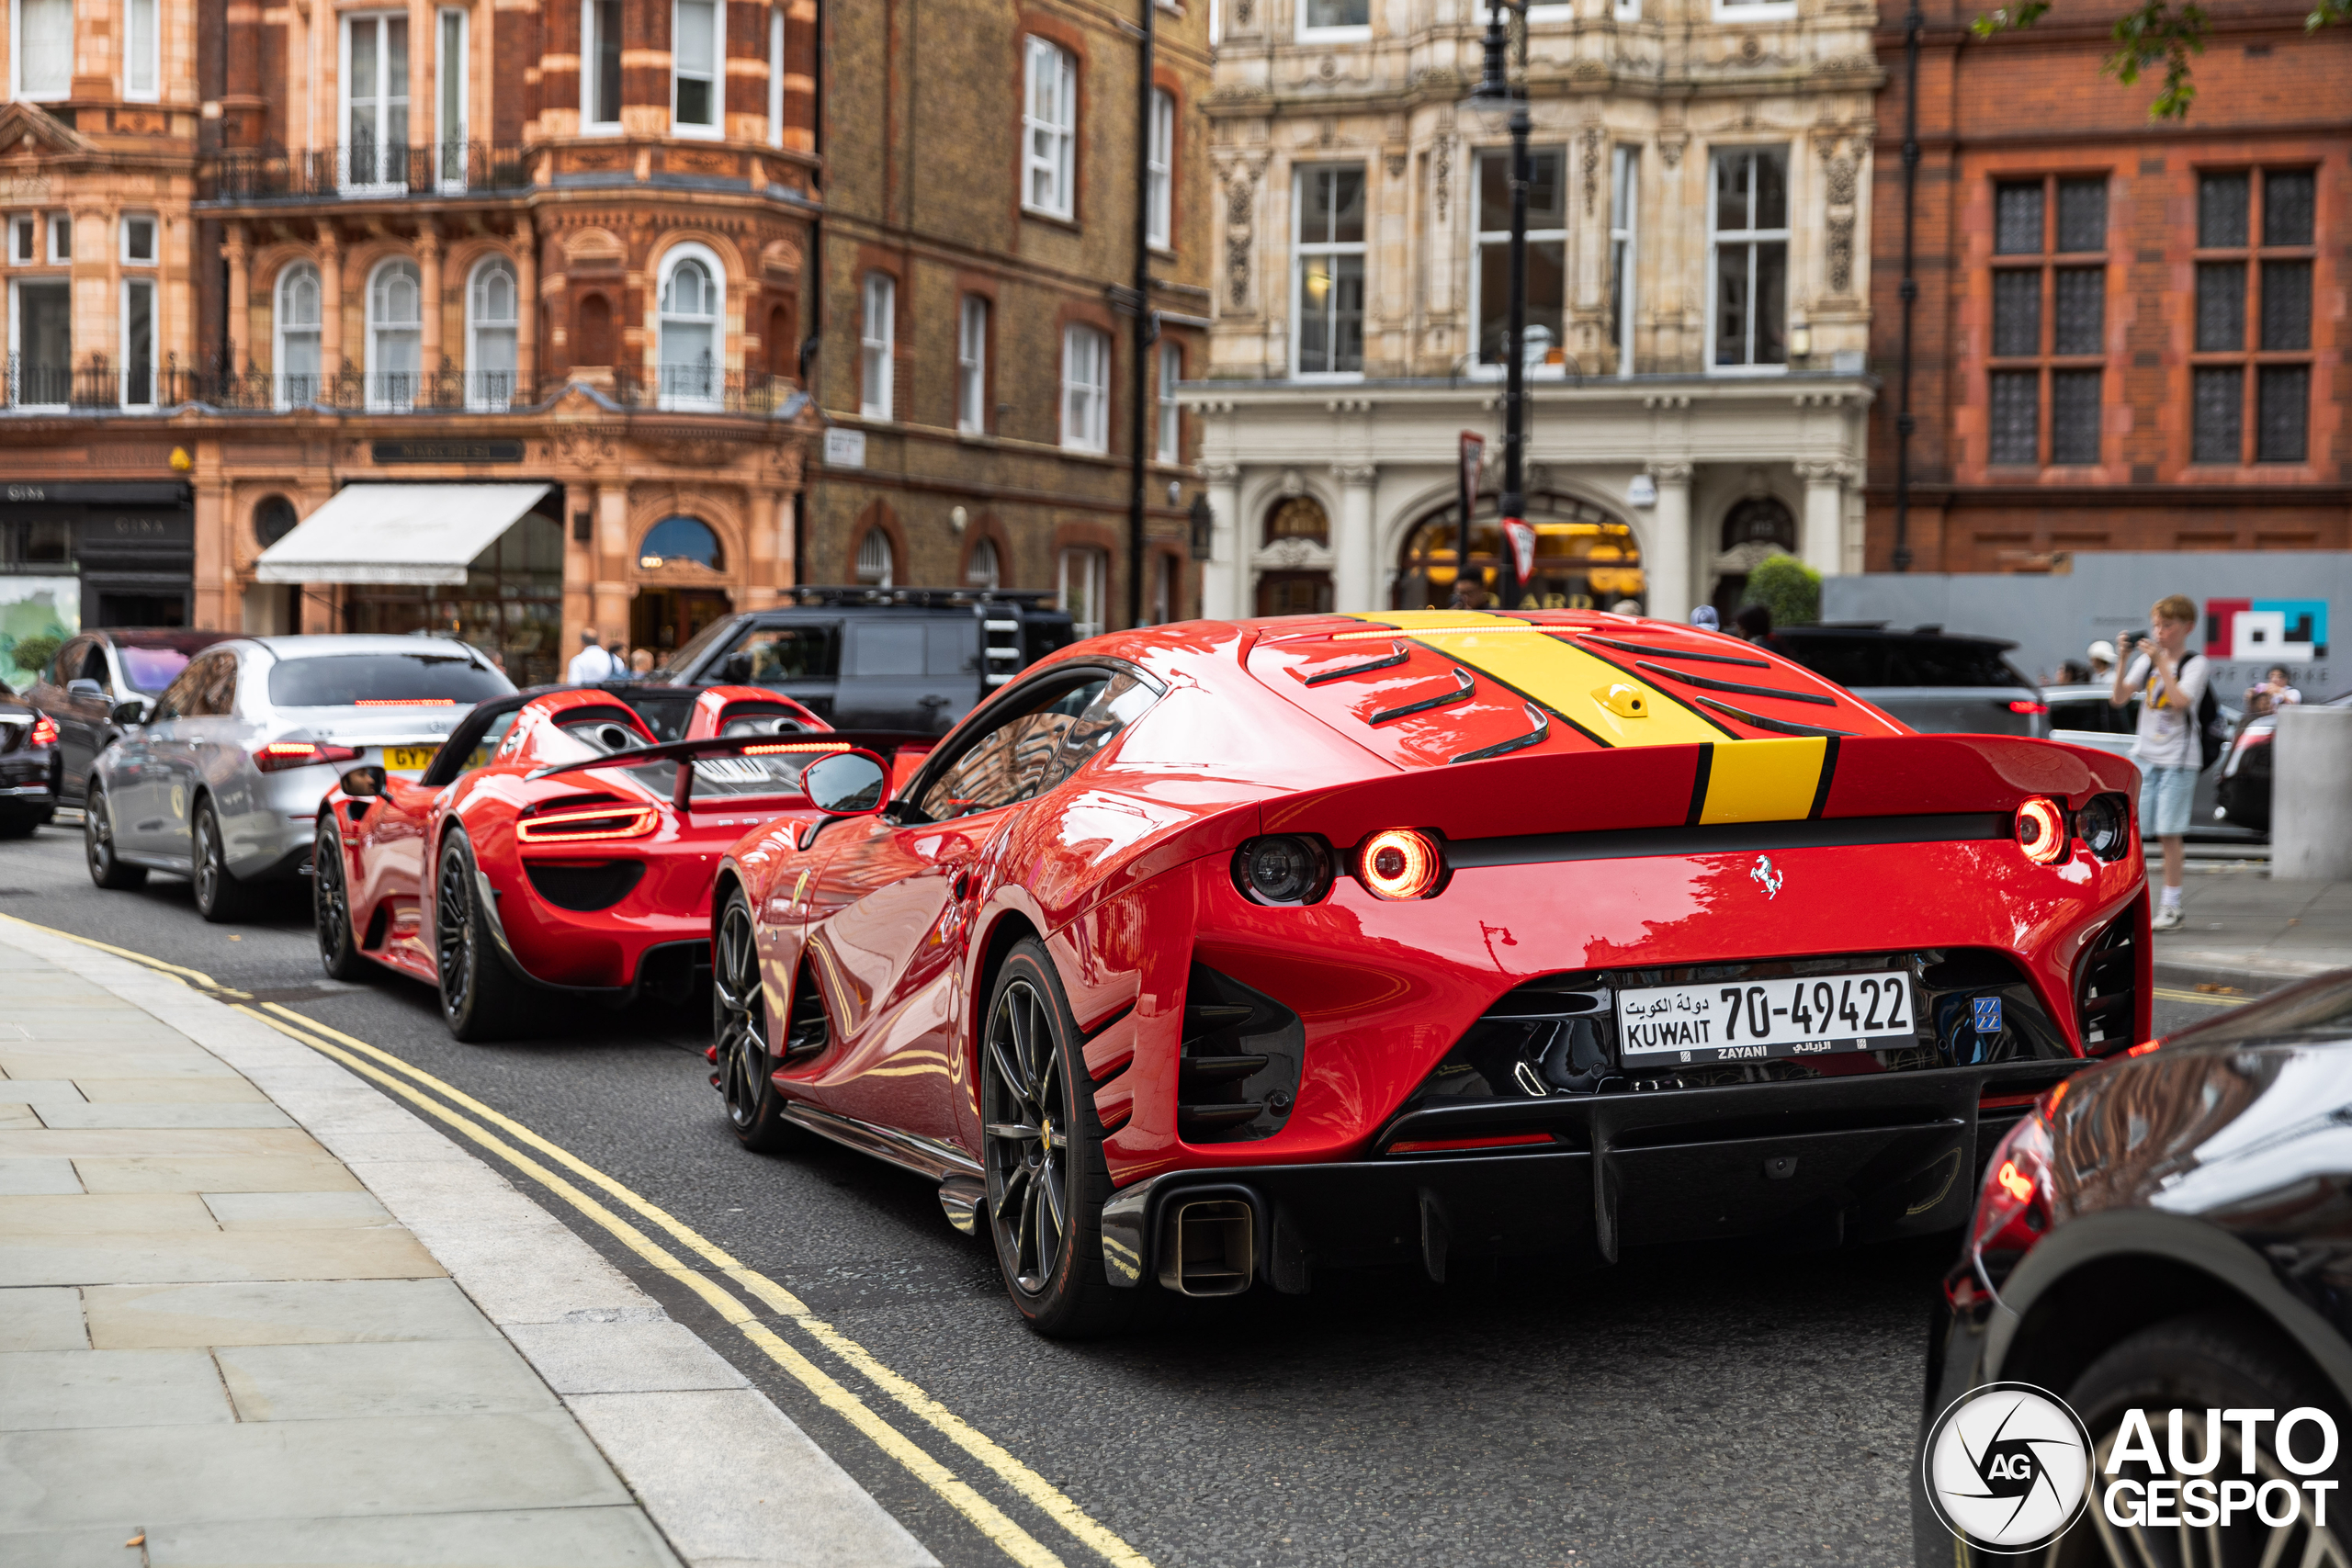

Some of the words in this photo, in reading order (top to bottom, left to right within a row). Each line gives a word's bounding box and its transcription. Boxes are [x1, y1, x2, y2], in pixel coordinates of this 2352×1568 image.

[114, 516, 164, 535] GINA
[1625, 997, 1672, 1020] الكويت
[1677, 992, 1709, 1015] دولة
[1721, 977, 1907, 1040] 70-49422
[1627, 1020, 1711, 1048] KUWAIT
[1718, 1045, 1768, 1060] ZAYANI
